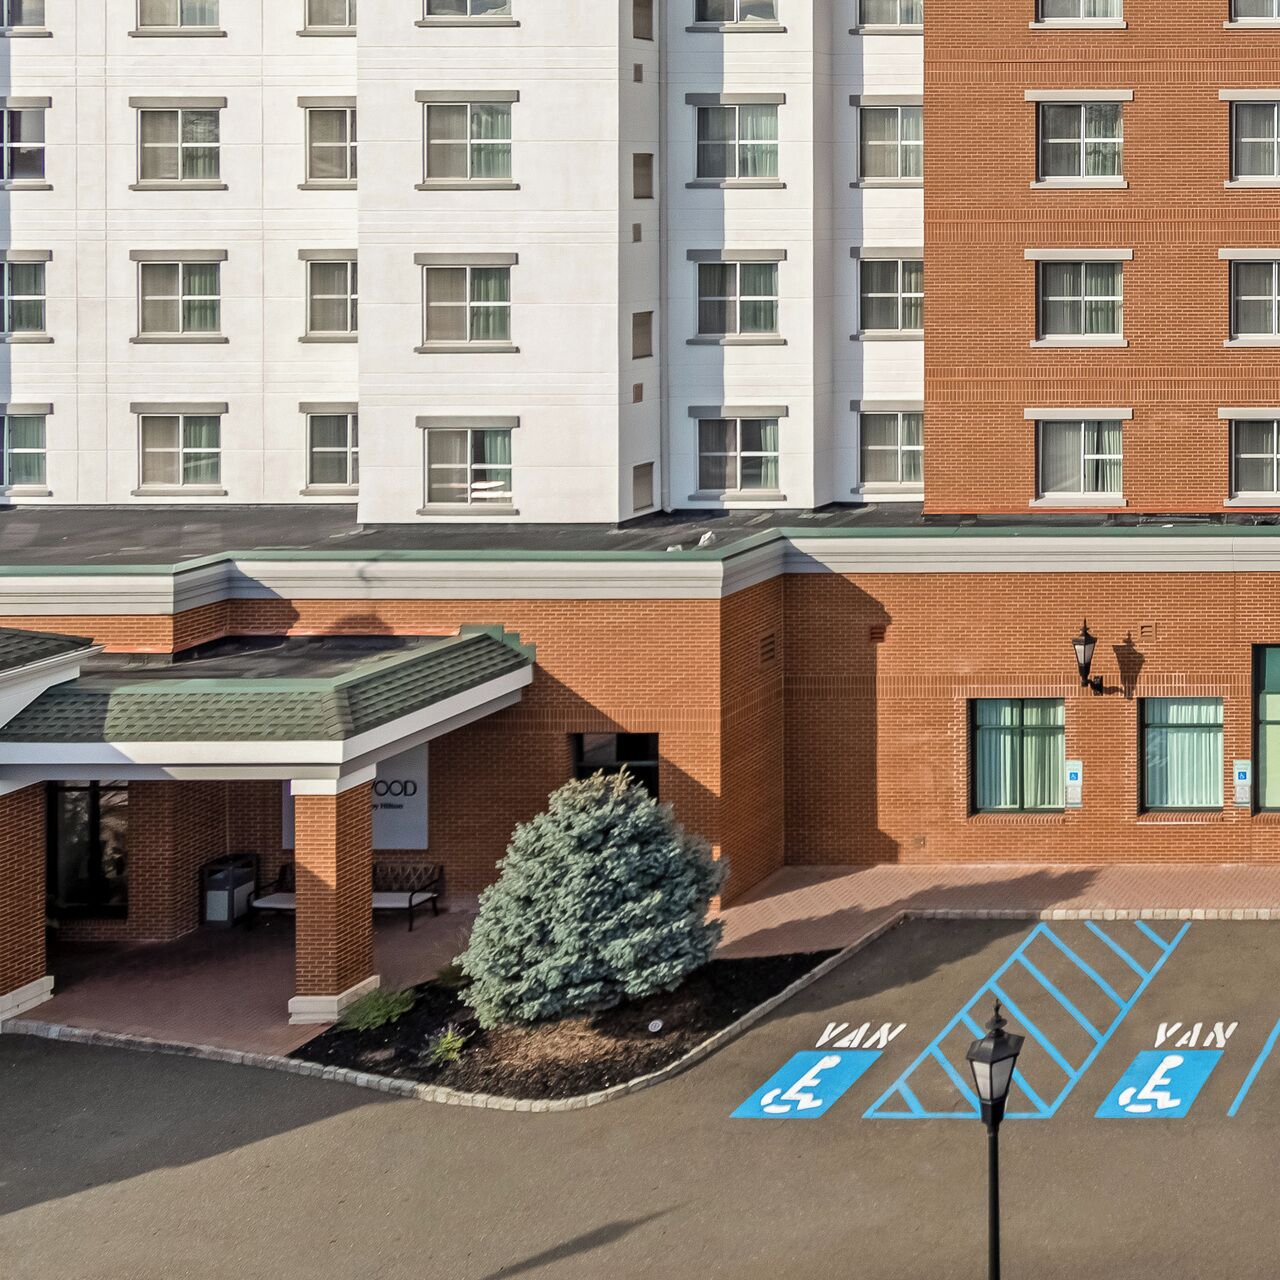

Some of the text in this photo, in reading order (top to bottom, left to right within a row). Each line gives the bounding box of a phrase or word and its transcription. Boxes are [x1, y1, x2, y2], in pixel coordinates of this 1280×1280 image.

[371, 780, 417, 797] OOD
[815, 1022, 907, 1049] VAN
[1153, 1022, 1239, 1048] VAN
